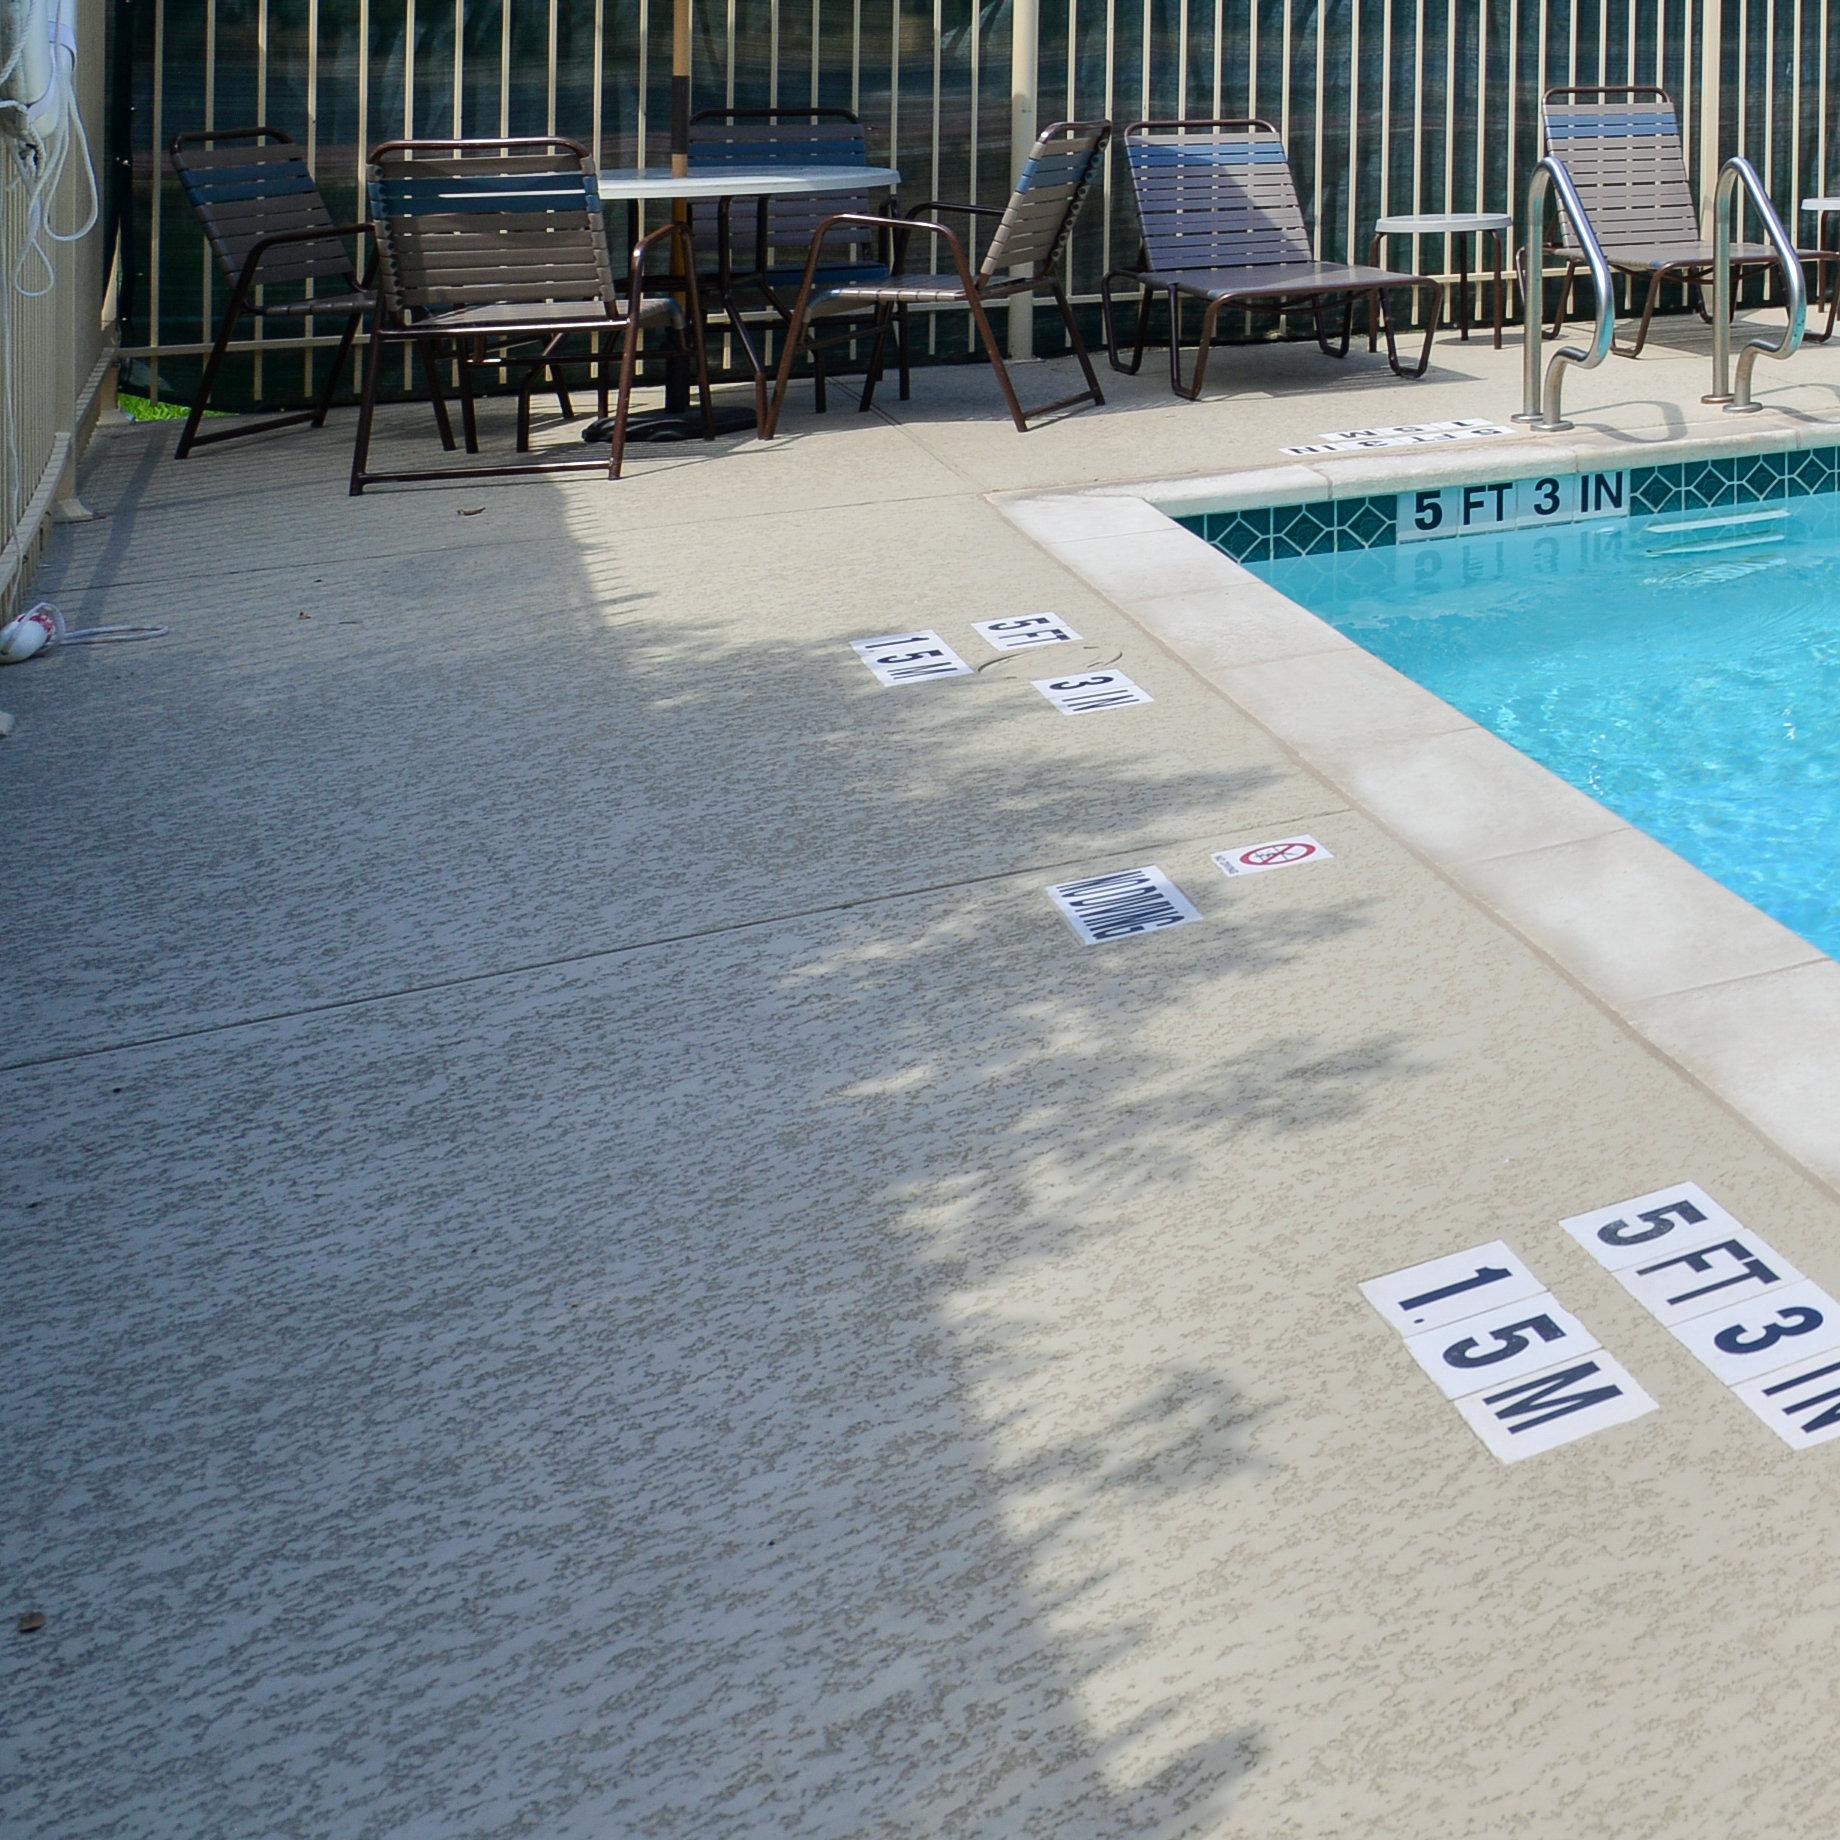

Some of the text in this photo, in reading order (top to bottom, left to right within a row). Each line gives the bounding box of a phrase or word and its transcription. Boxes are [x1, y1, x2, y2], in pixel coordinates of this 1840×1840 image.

[1414, 471, 1623, 530] 5 FT 3 IN
[988, 616, 1072, 647] 5 FT
[886, 661, 958, 680] M
[1049, 675, 1140, 712] 3 IN
[1056, 870, 1185, 940] NO DIVING
[1596, 1199, 1709, 1248] 5
[1635, 1238, 1782, 1306] FT
[1397, 1265, 1624, 1435] 1.5 M
[1713, 1305, 1825, 1355] 3
